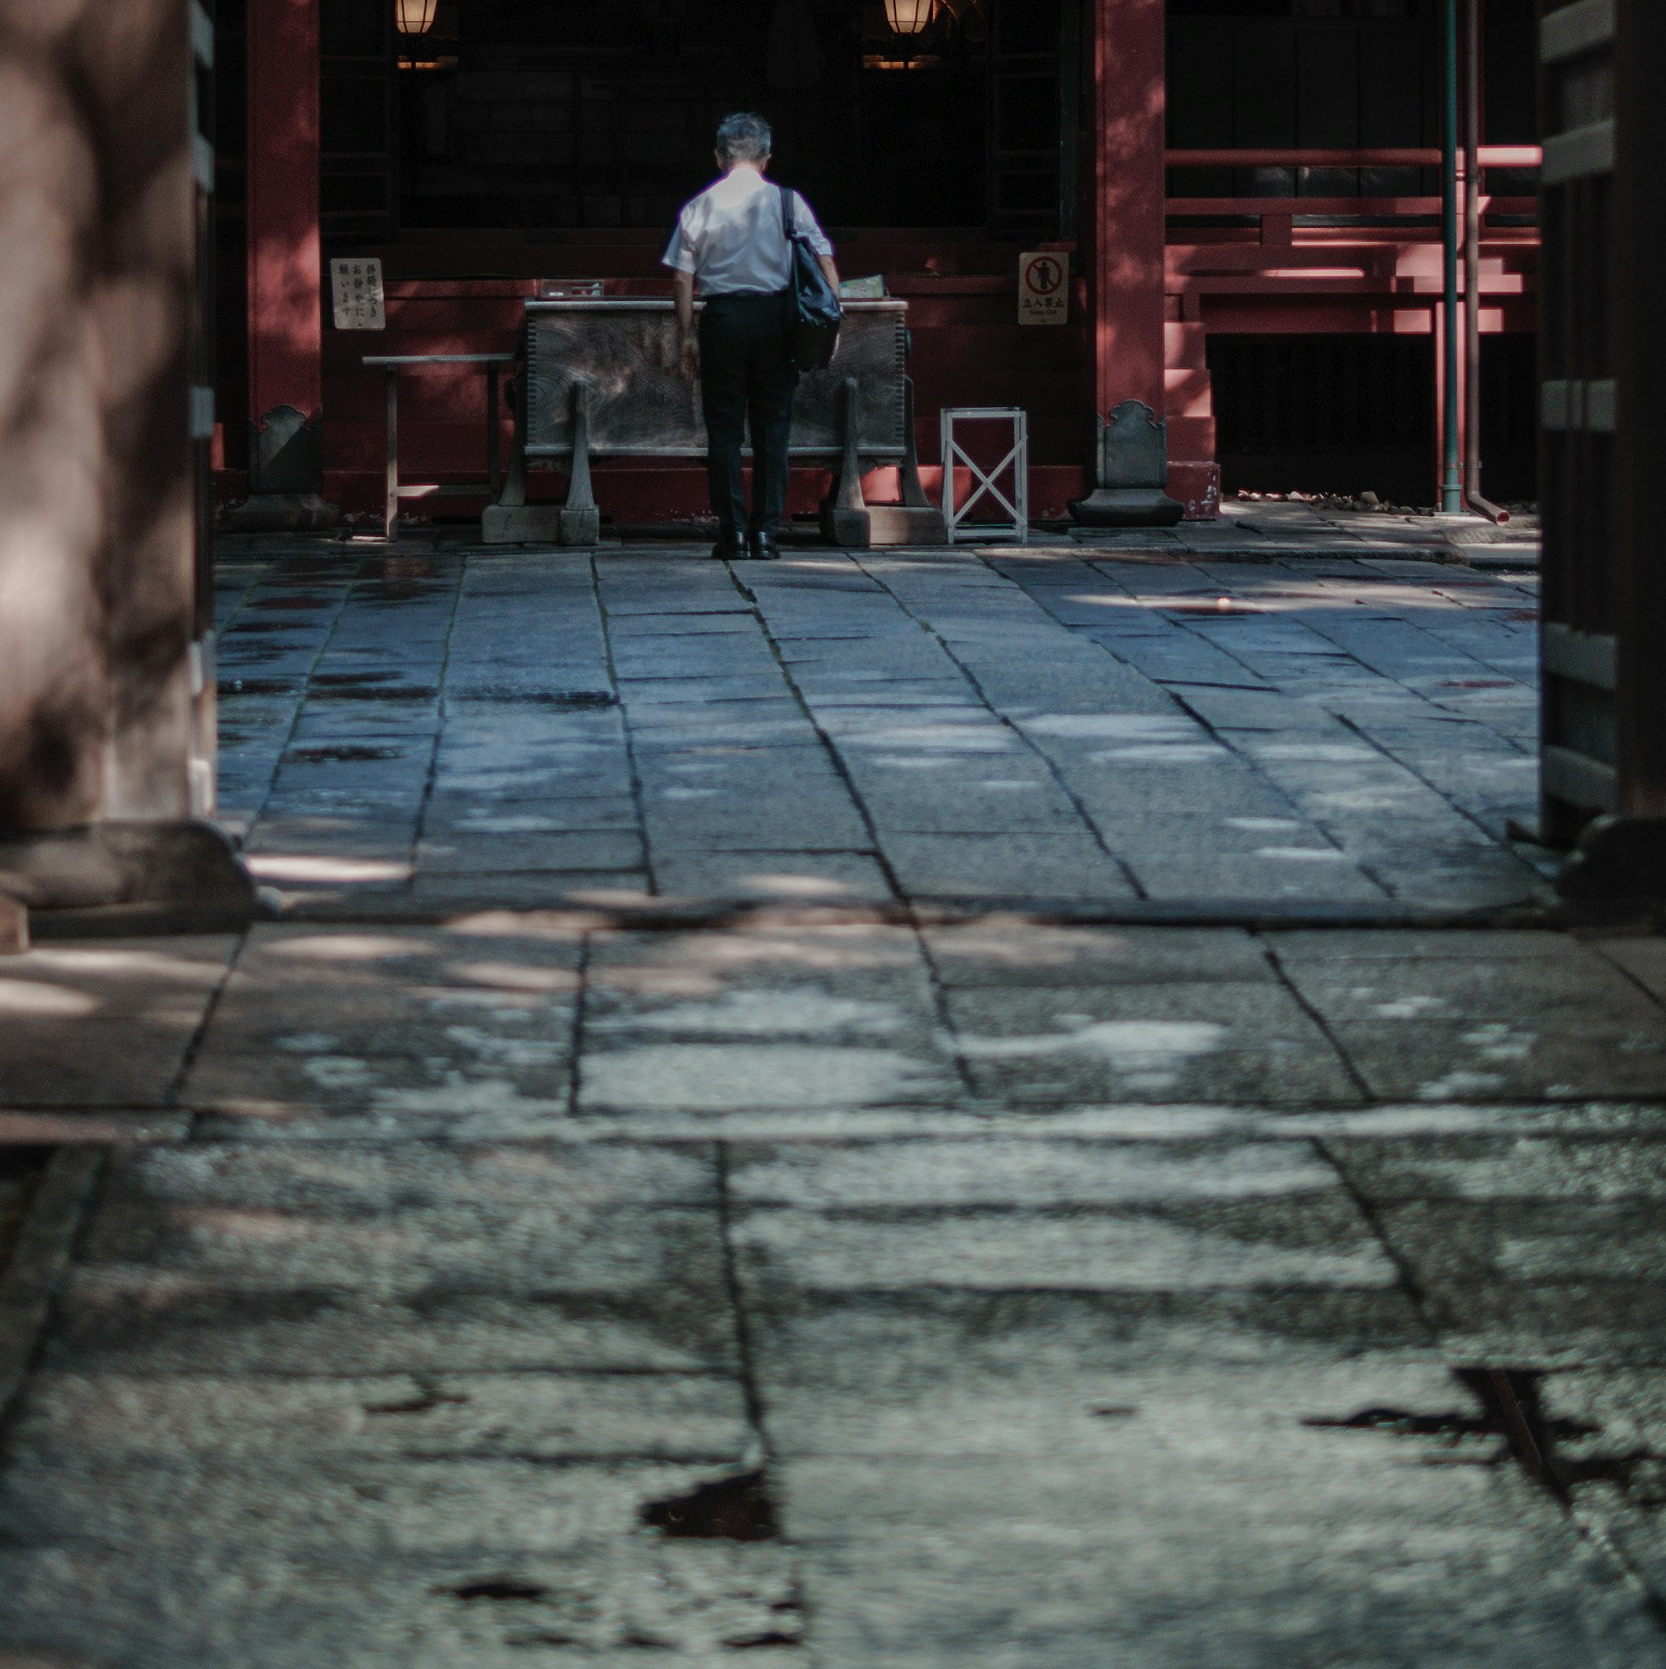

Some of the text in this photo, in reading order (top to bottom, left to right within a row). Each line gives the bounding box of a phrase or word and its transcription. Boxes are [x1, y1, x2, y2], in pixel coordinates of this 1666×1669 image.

[339, 264, 351, 316] 願います
[353, 264, 365, 317] お静かに
[1022, 297, 1065, 308] 立入禁止
